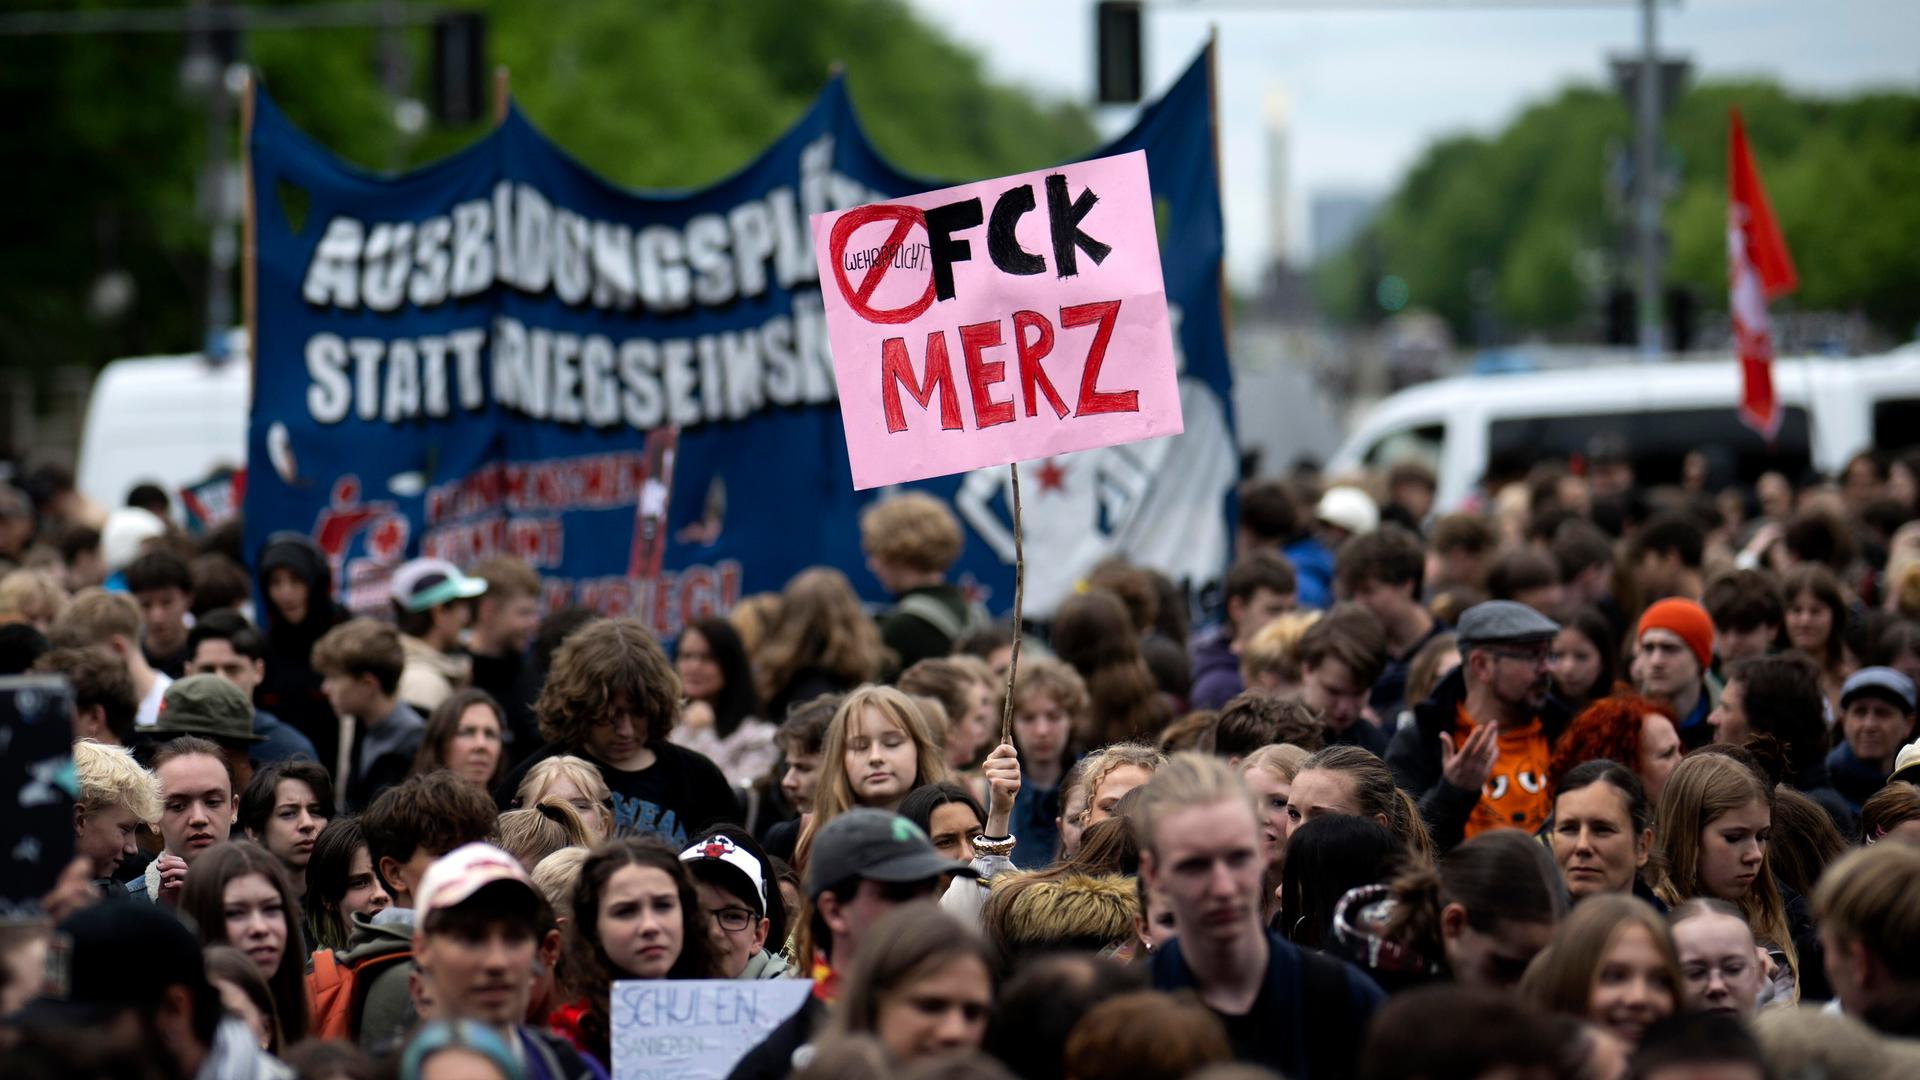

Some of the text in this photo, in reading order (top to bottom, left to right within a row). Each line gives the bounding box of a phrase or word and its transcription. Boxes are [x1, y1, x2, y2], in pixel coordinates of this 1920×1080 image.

[844, 242, 931, 271] WEHRPFLICHT
[923, 171, 1112, 302] FCK
[304, 328, 485, 425] STATT
[882, 300, 1139, 433] MERZ
[616, 986, 757, 1028] SCHULEN
